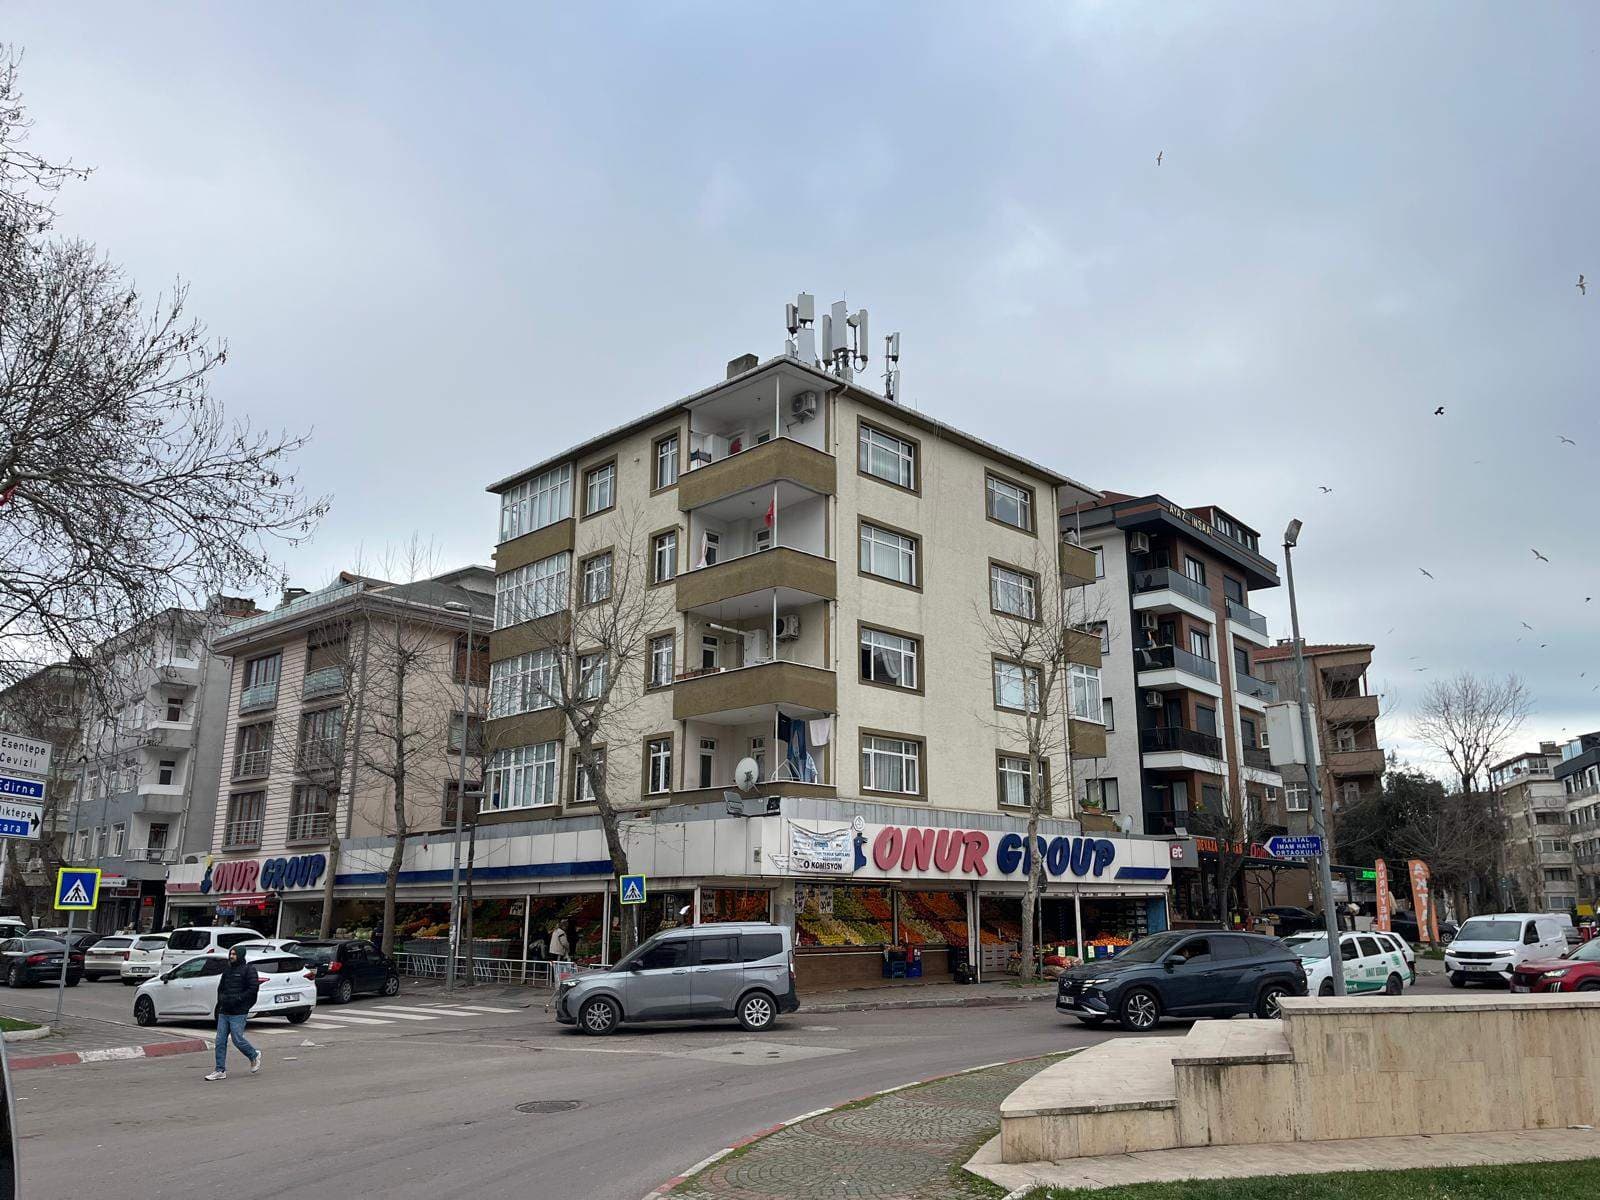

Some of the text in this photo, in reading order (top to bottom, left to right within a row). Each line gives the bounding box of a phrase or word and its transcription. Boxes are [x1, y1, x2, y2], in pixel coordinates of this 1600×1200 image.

[1, 737, 46, 756] Esentepe
[0, 752, 37, 768] Cevizli
[0, 823, 21, 833] ara
[873, 826, 1116, 877] ONUR GROUP
[1171, 846, 1183, 857] et
[213, 853, 326, 892] ONUR GROUP
